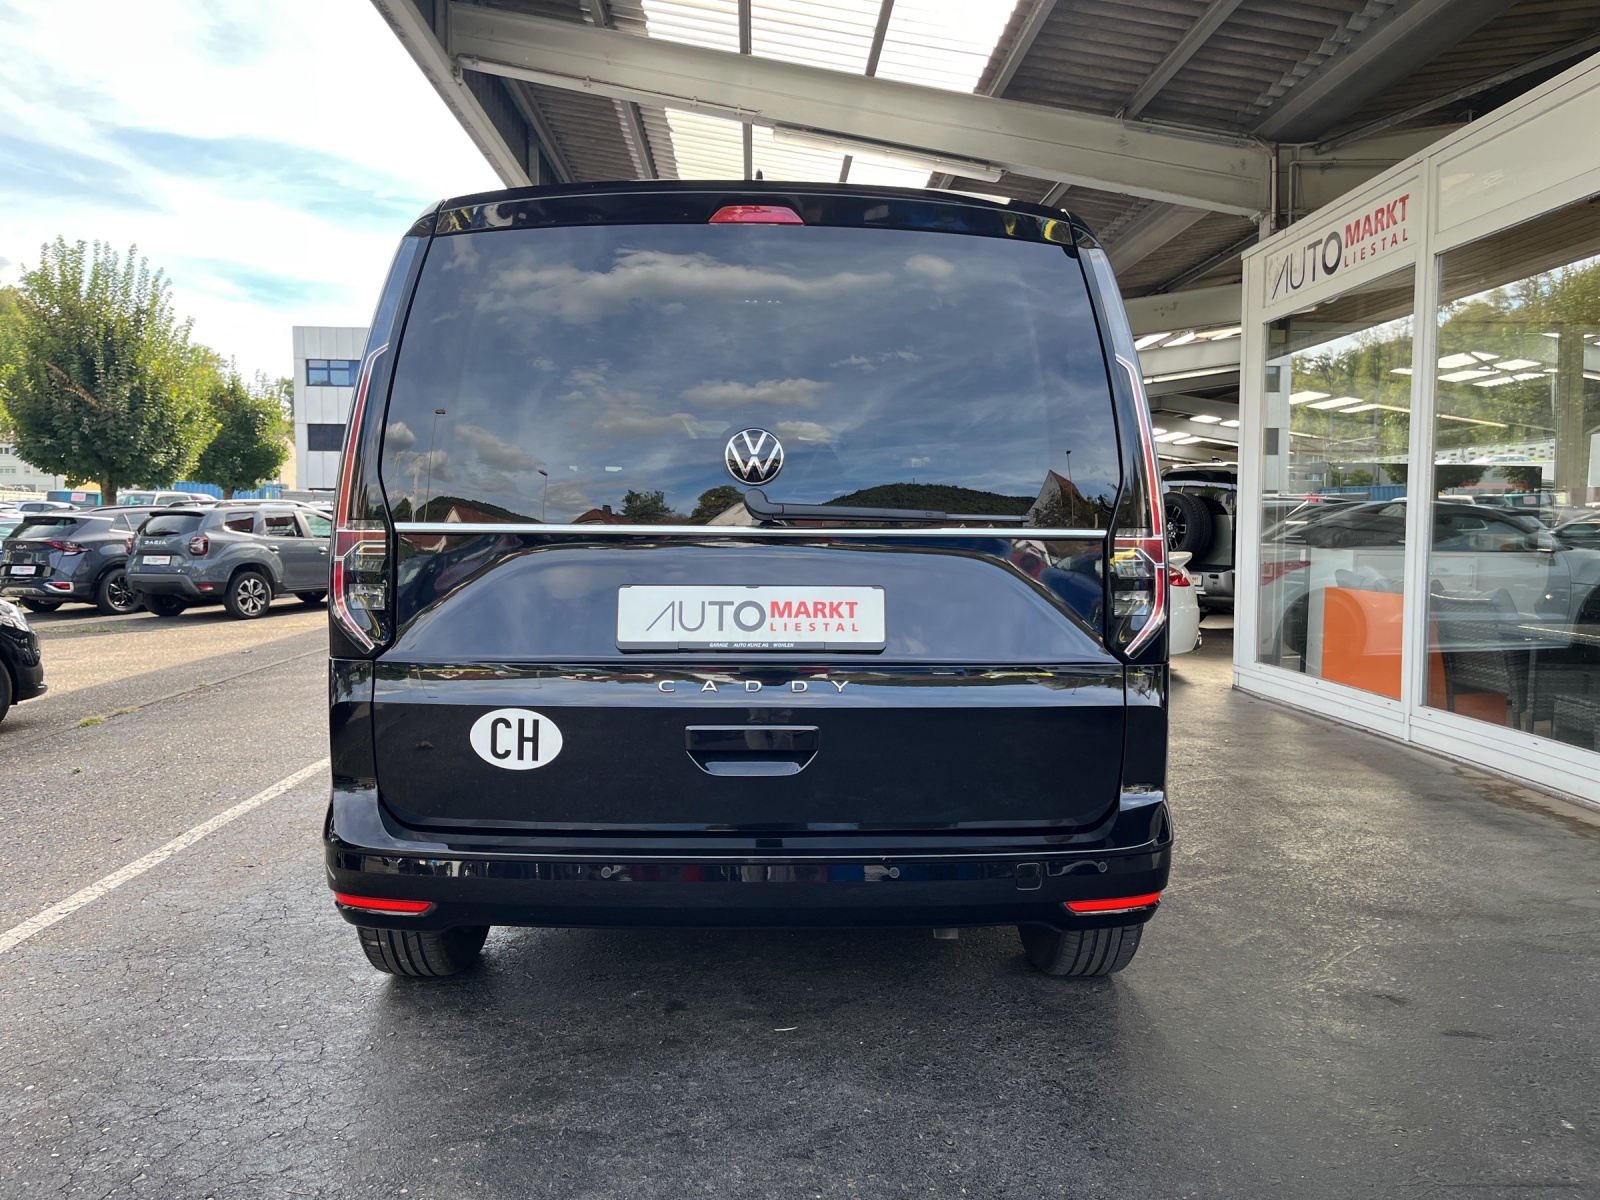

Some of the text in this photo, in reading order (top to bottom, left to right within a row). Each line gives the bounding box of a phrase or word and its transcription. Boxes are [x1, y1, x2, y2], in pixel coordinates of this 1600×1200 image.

[1271, 194, 1410, 300] AUTO MARKT
[1344, 228, 1409, 268] LIESTAL
[645, 600, 859, 632] AUTO MARKT
[769, 622, 859, 632] LIESTAL
[658, 680, 849, 693] CADDY
[490, 717, 540, 762] CH
